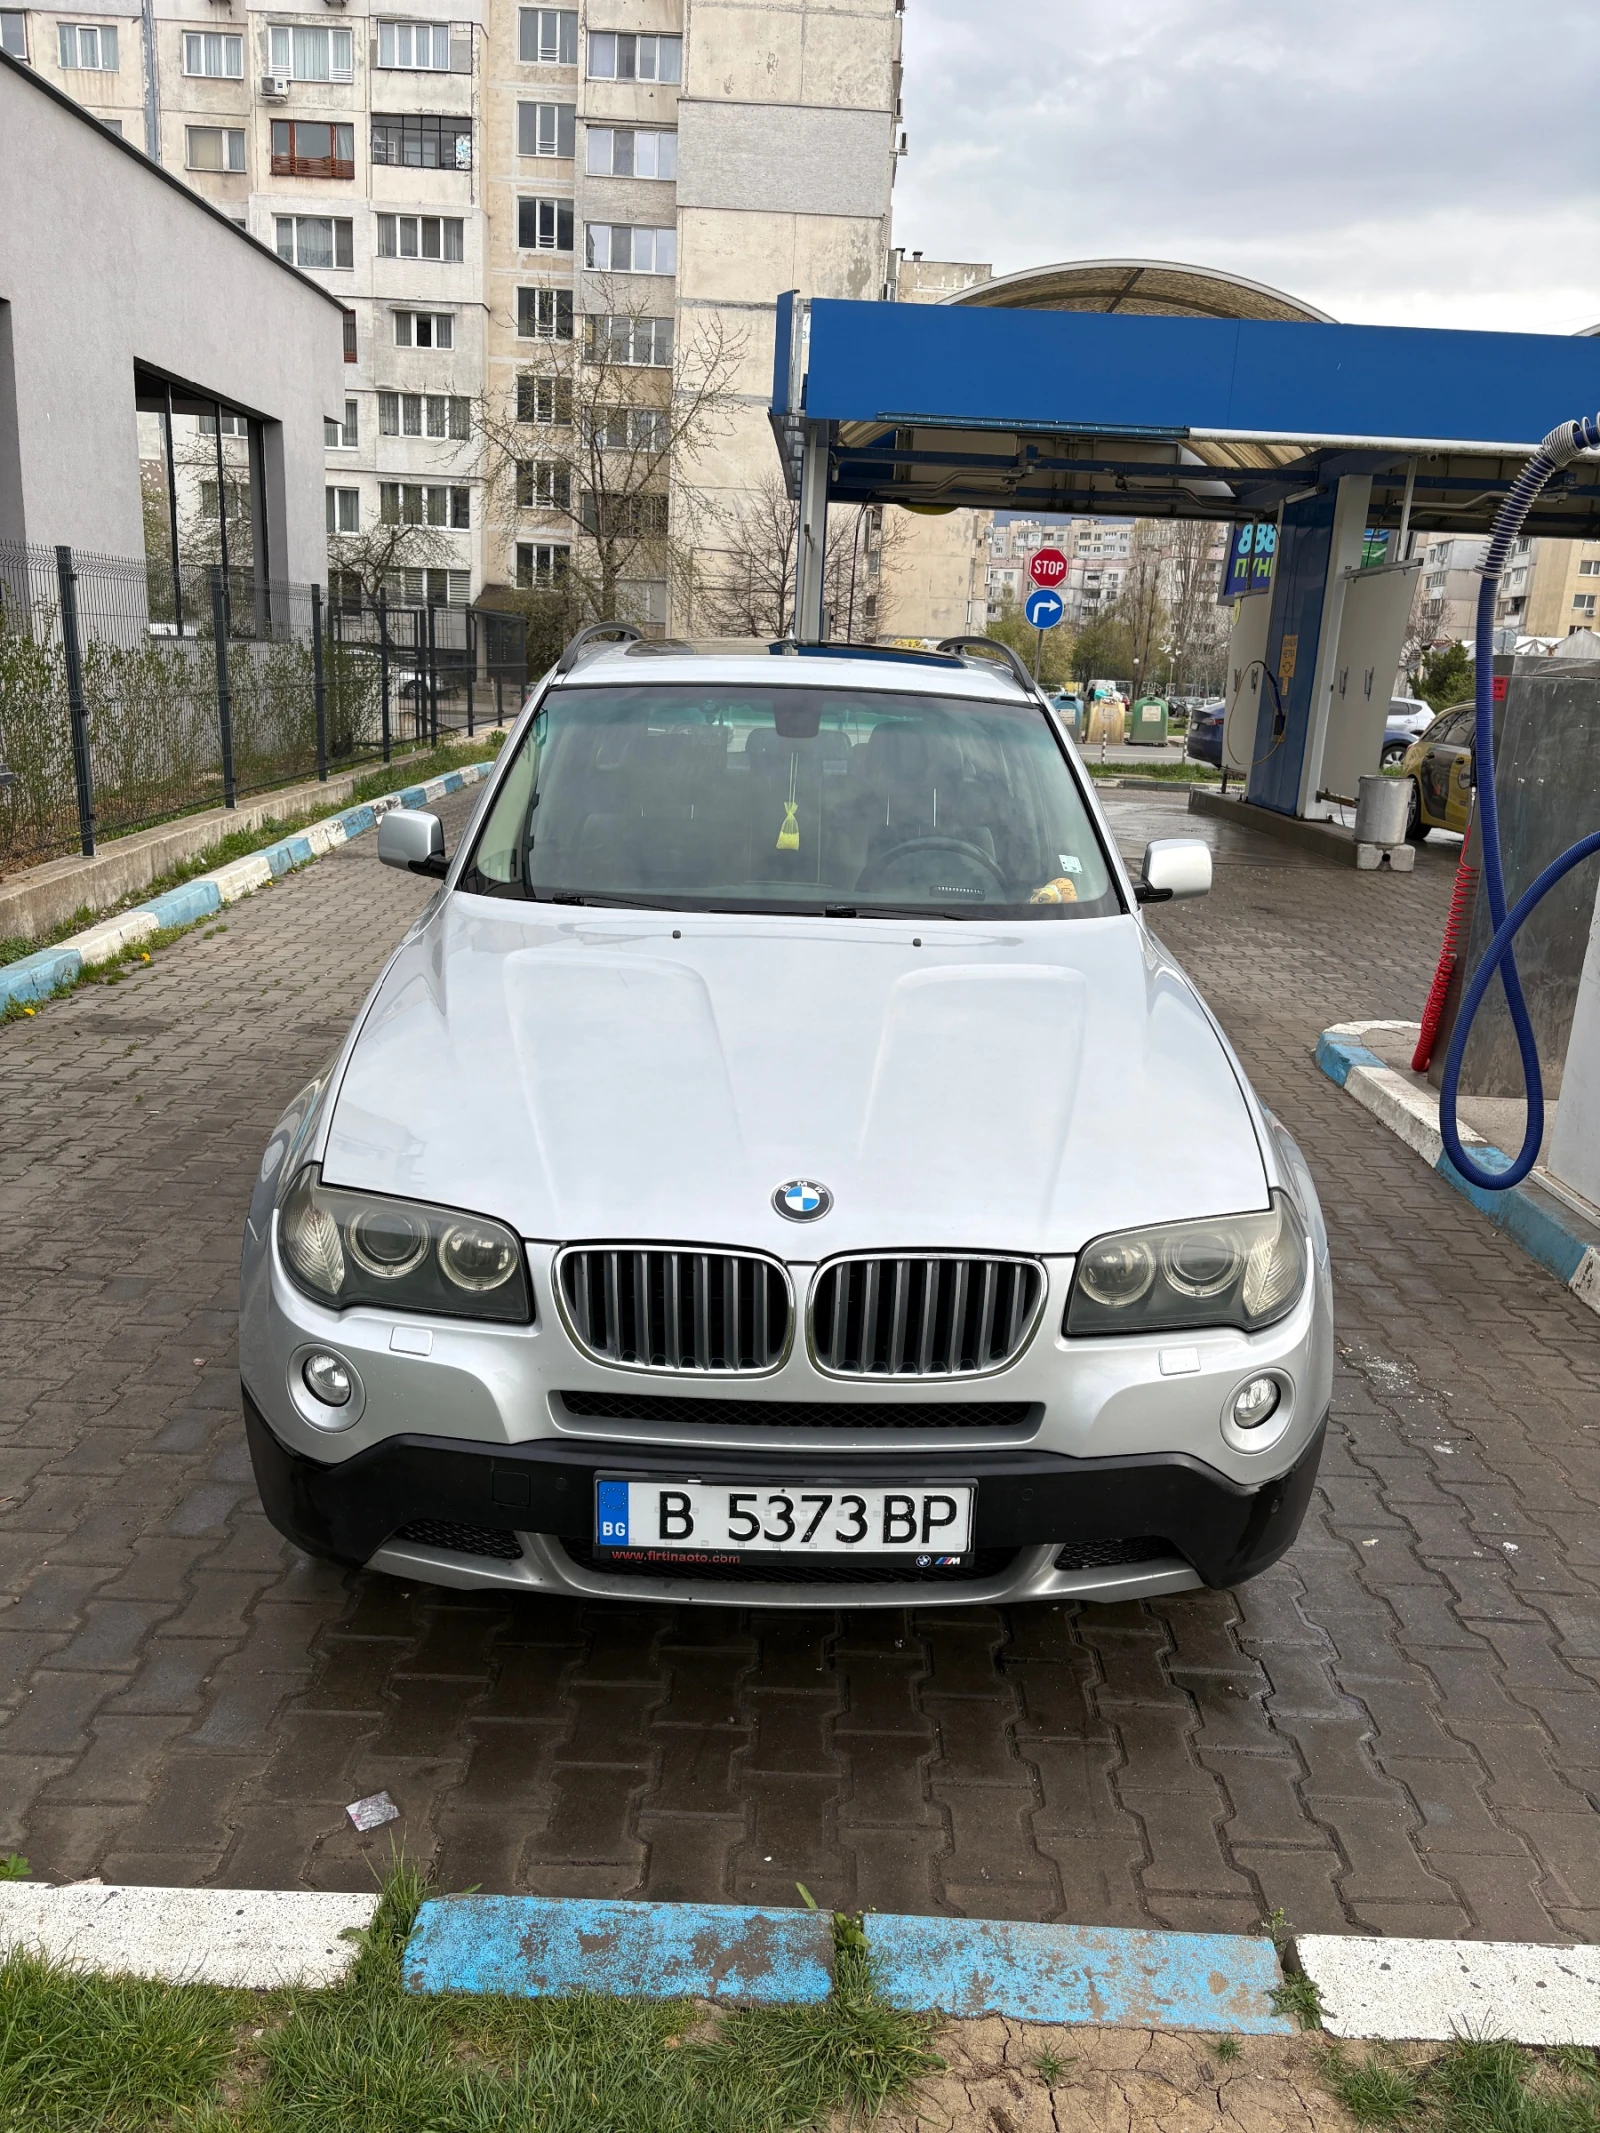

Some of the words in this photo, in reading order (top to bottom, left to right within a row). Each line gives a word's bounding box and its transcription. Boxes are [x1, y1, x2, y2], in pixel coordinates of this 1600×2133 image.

[1238, 524, 1276, 554] 888
[1034, 560, 1064, 575] STOP
[1234, 557, 1273, 578] ПУН
[780, 1181, 826, 1194] BMW
[659, 1490, 695, 1540] B
[728, 1493, 869, 1544] 5373
[883, 1495, 957, 1544] BP
[602, 1521, 626, 1537] BG
[611, 1550, 741, 1565] www.firtinaoto.com
